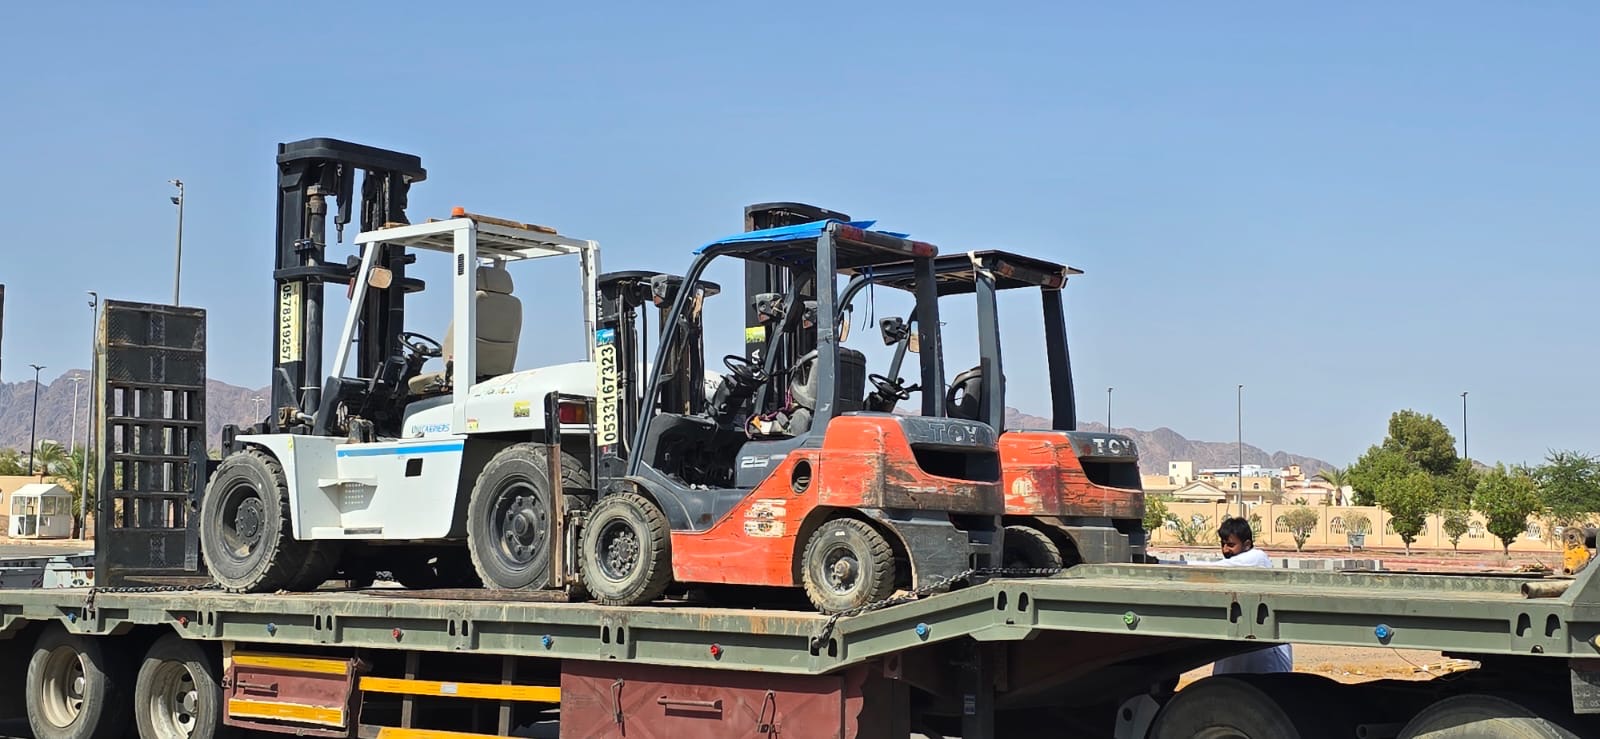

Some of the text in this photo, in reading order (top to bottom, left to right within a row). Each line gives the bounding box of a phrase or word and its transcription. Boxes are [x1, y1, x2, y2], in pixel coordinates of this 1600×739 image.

[282, 284, 292, 360] 0578319257
[601, 346, 616, 442] 0533167323
[741, 455, 769, 468] 25
